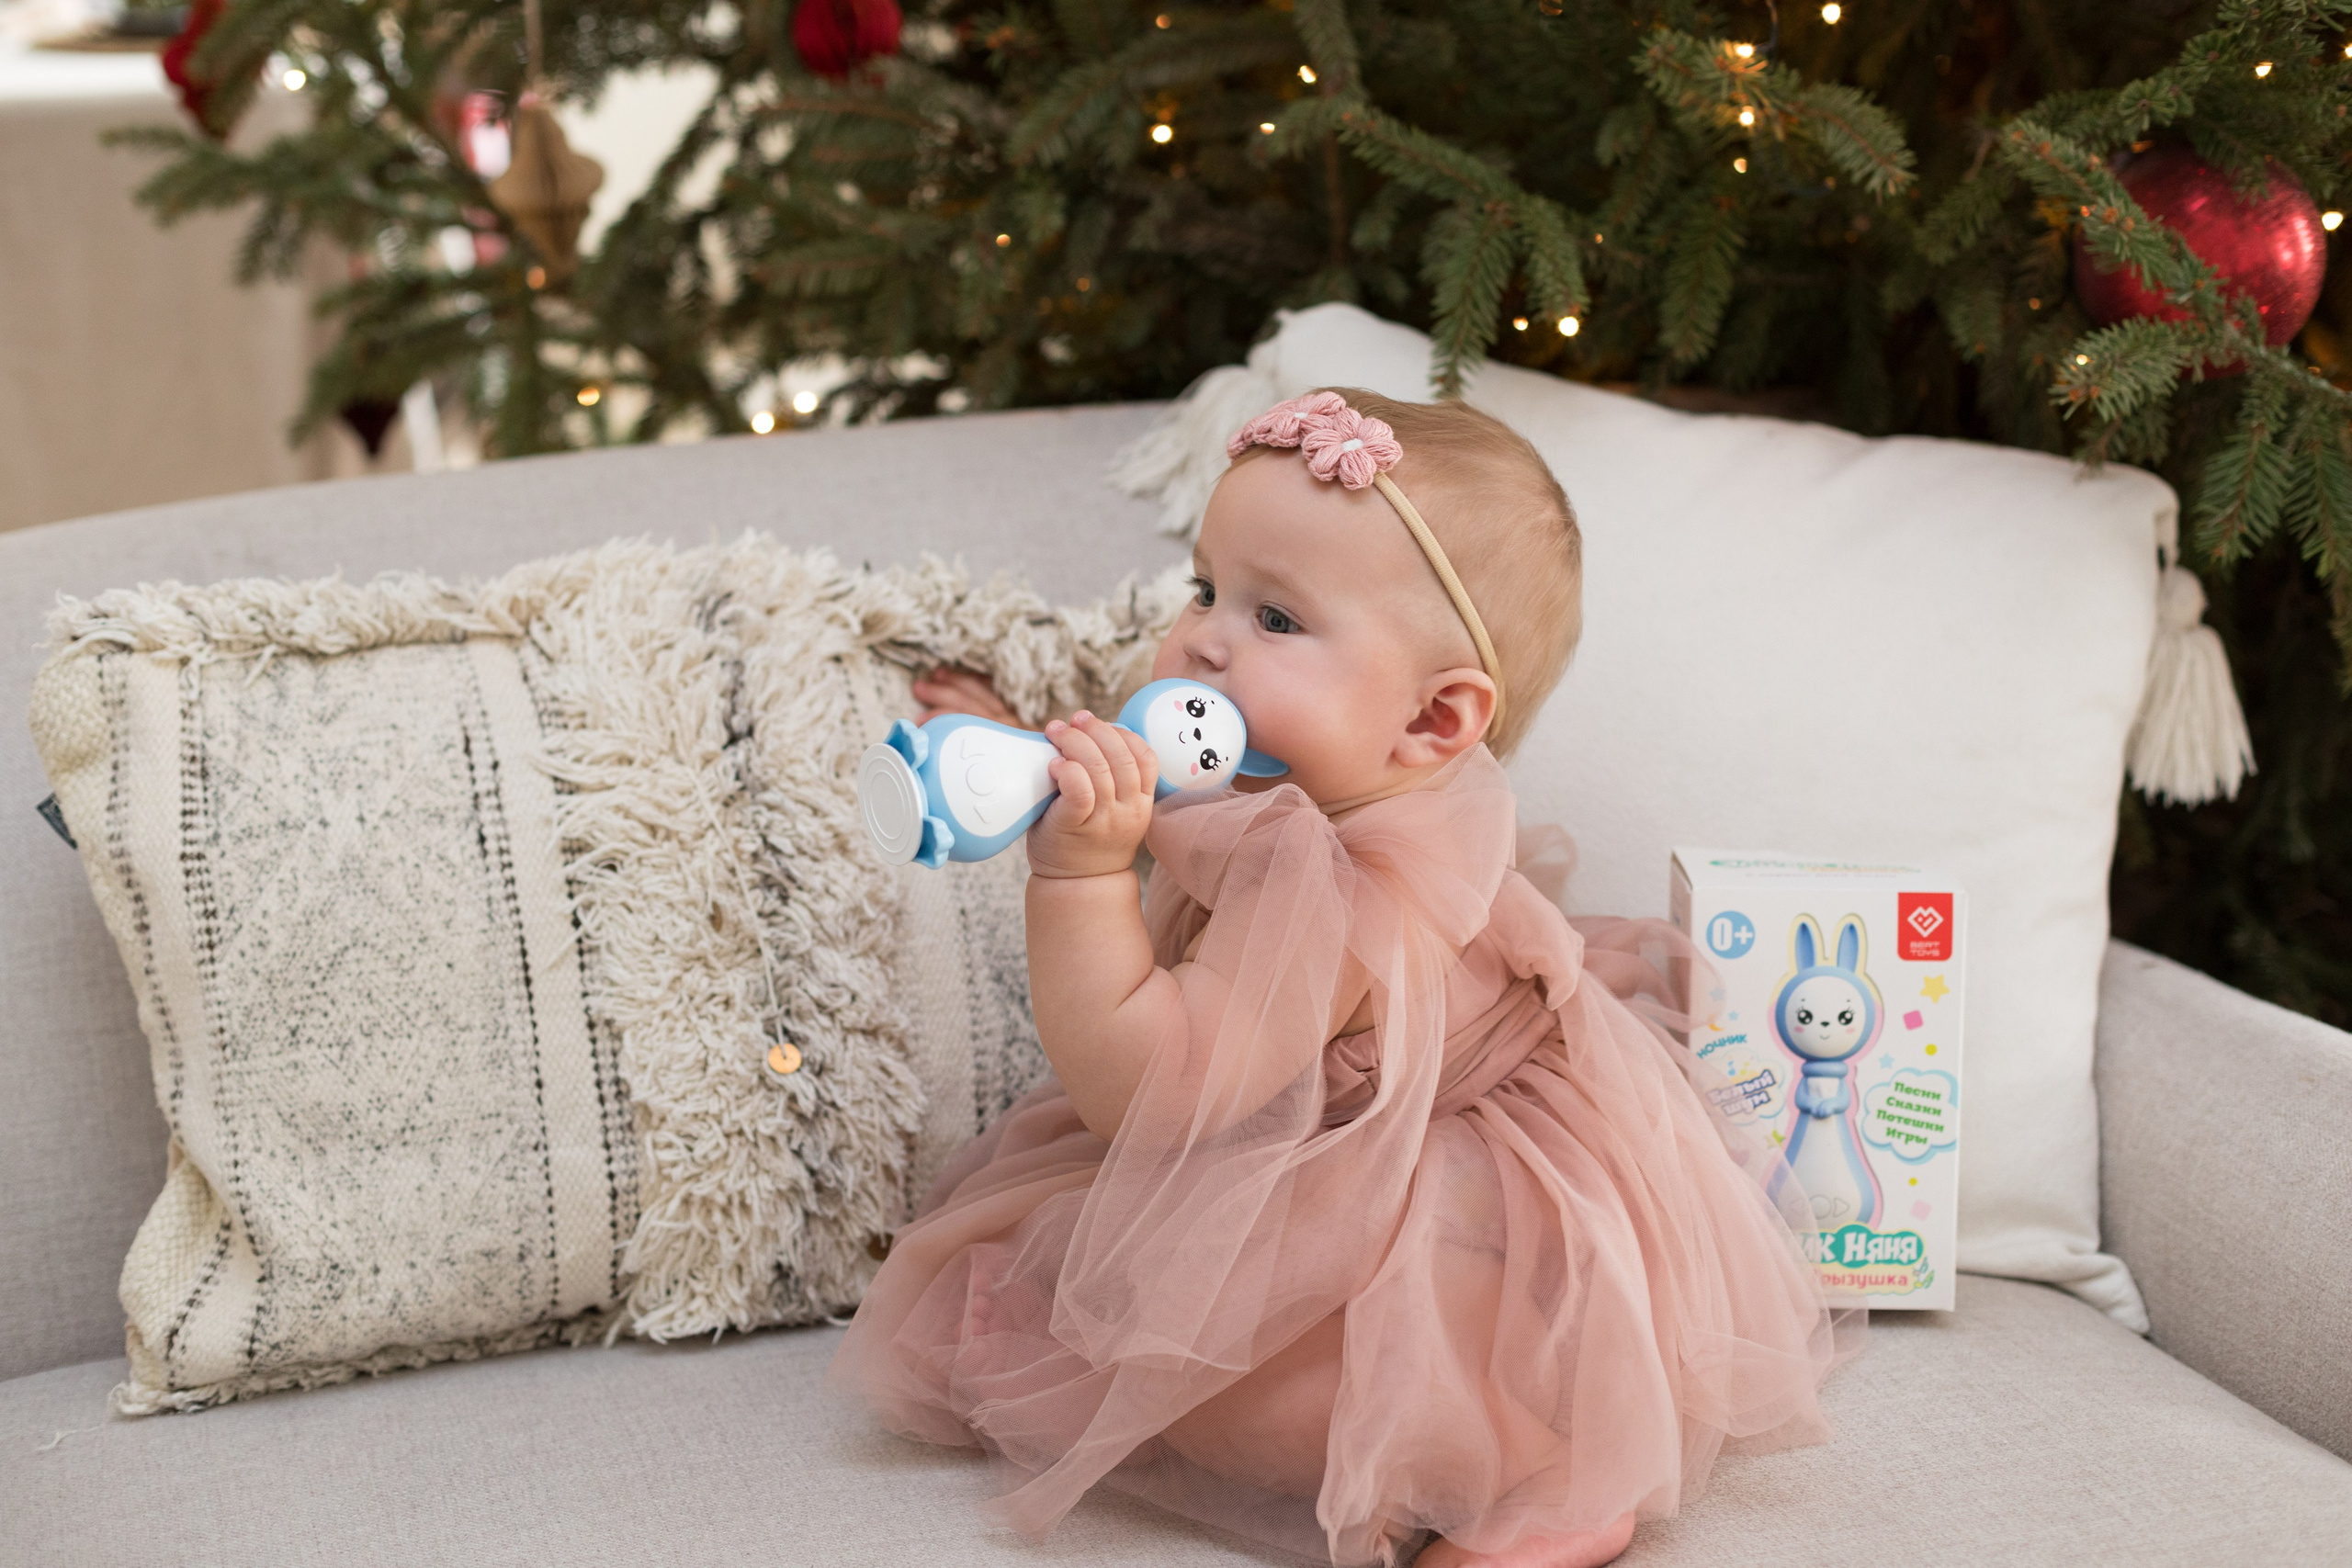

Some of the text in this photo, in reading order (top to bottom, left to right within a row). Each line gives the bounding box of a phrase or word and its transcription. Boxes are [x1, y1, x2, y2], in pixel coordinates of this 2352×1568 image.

[1713, 918, 1753, 952] 0+
[1894, 1082, 1940, 1100] Песни
[1886, 1097, 1941, 1116] Сказки
[1876, 1109, 1944, 1133] Потешки
[1886, 1127, 1928, 1145] Игры
[1815, 1269, 1908, 1289] рызушка
